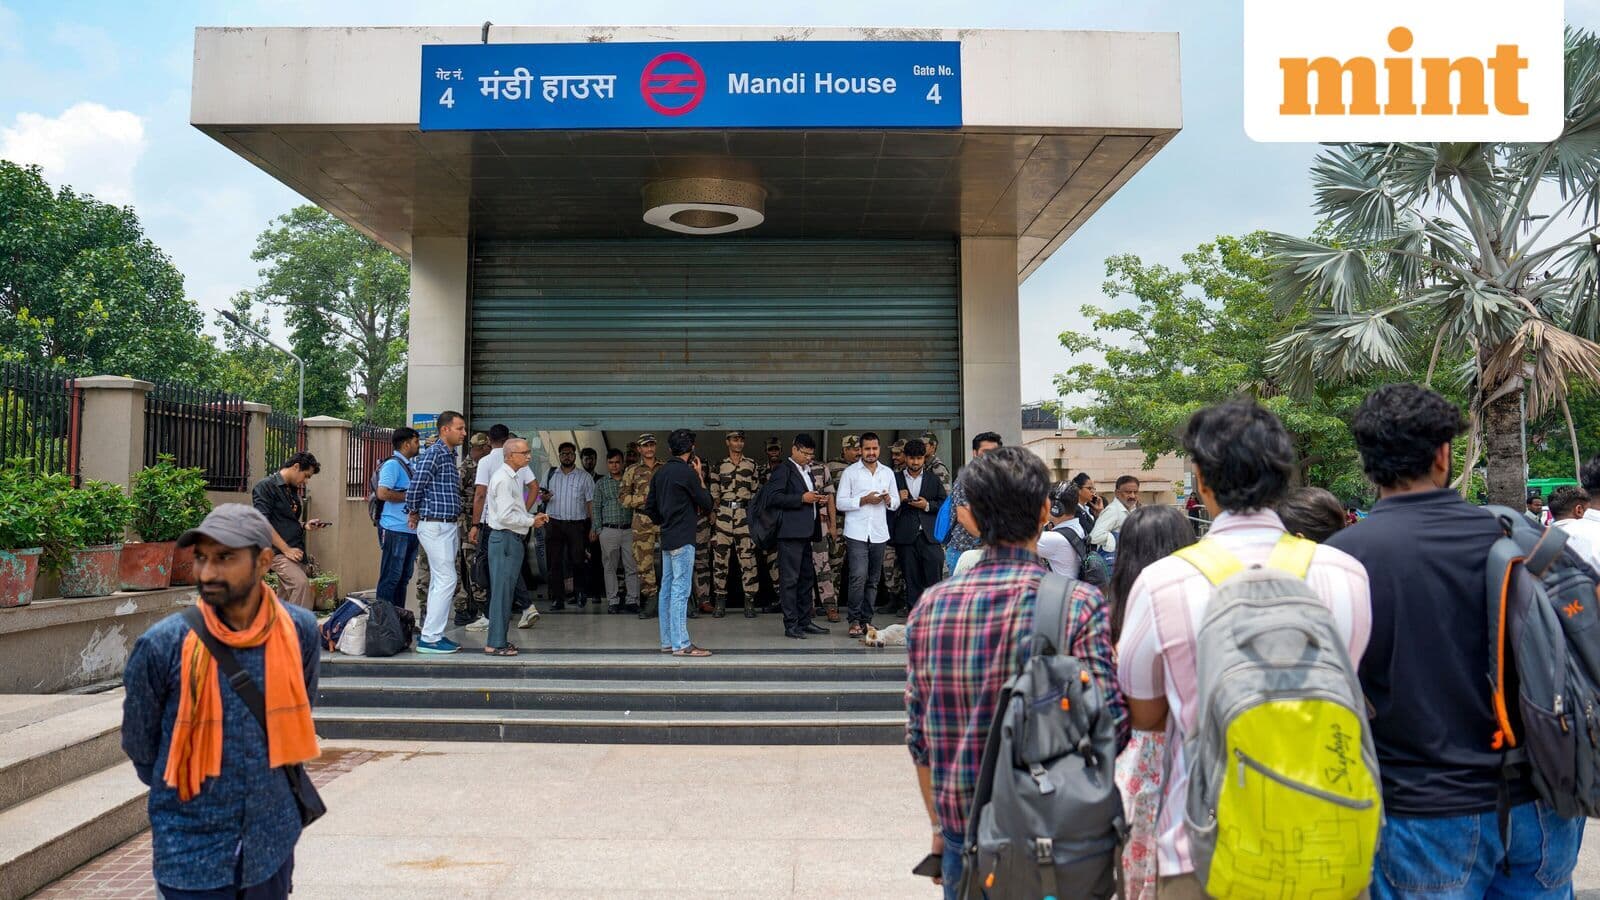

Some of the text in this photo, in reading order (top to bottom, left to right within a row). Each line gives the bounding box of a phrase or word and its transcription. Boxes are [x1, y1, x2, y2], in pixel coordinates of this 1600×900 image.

[435, 67, 451, 81] गेट
[913, 64, 955, 76] Gate No.
[478, 67, 617, 103] मंडी हाउस
[728, 72, 897, 94] Mandi House
[926, 83, 942, 105] 4
[439, 87, 455, 109] 4
